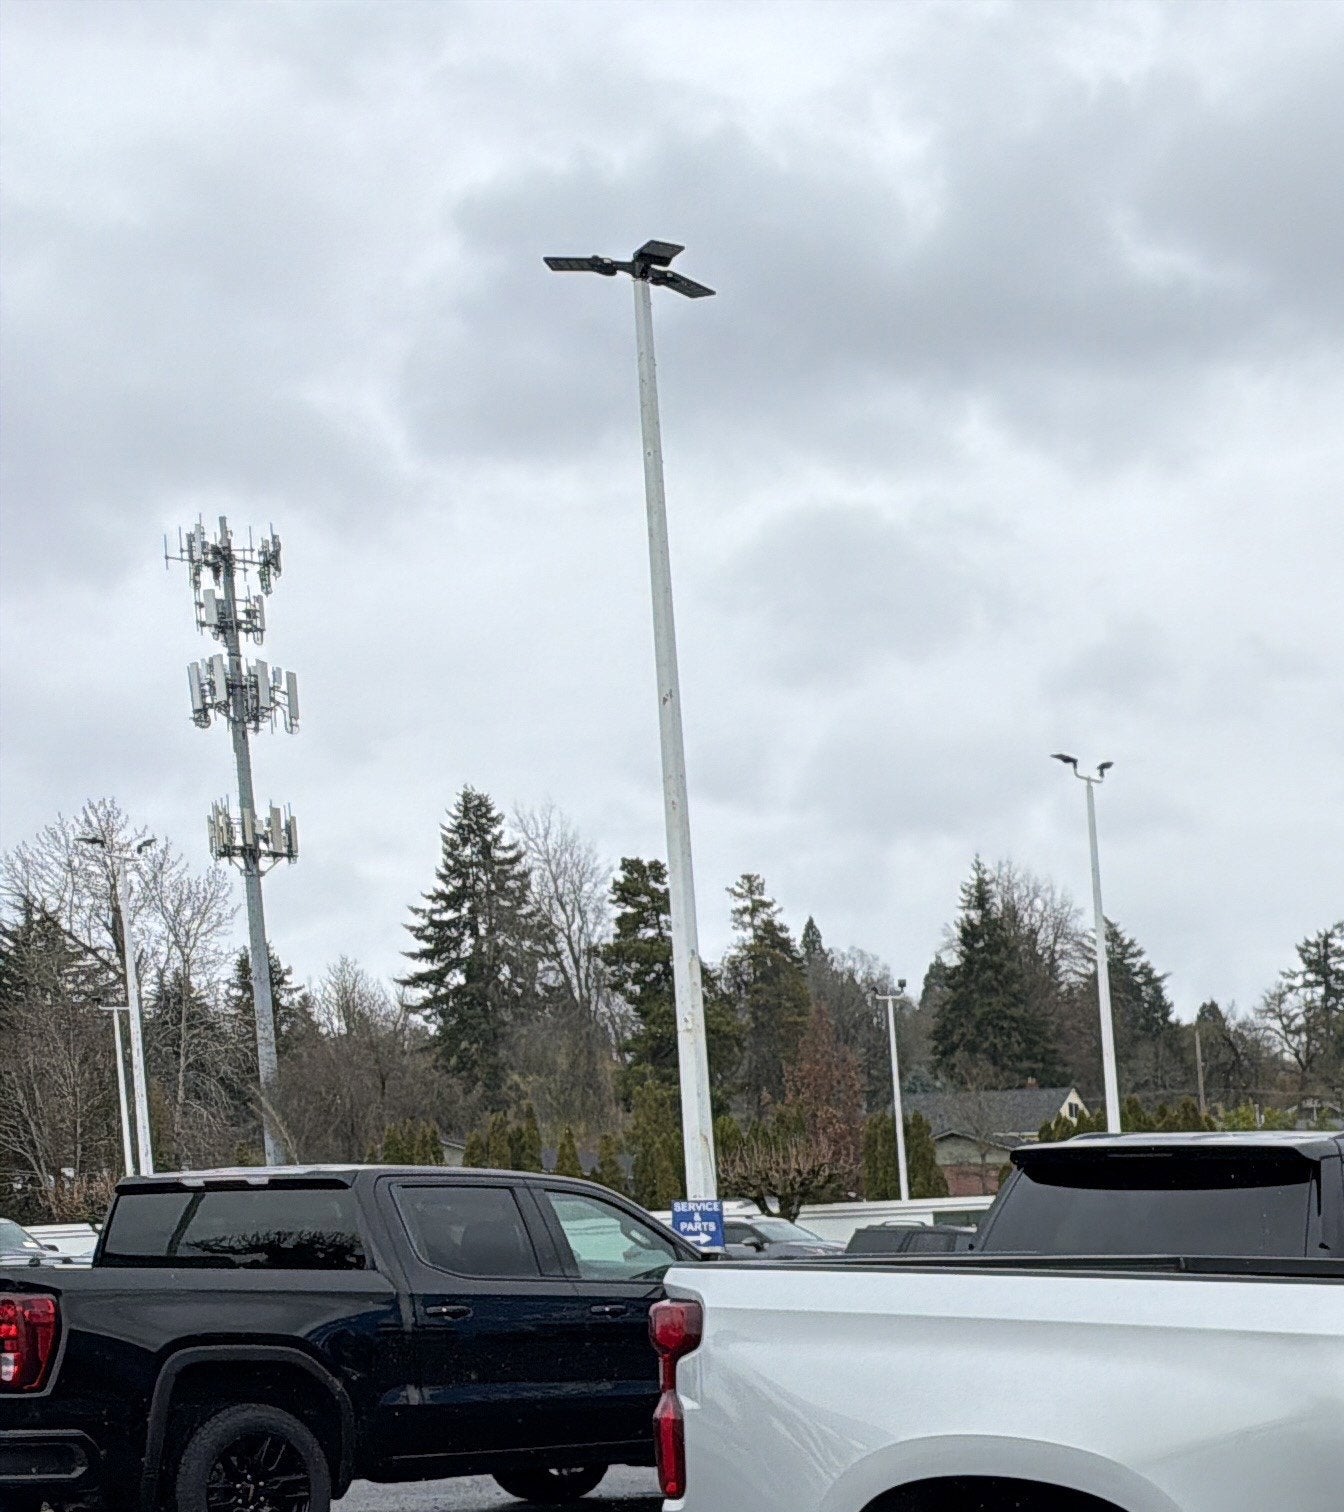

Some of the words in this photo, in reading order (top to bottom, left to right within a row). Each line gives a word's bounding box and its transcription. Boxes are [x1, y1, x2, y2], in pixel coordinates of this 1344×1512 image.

[673, 1201, 720, 1212] SERVICE
[693, 1211, 701, 1221] &
[680, 1221, 716, 1231] PARTS
